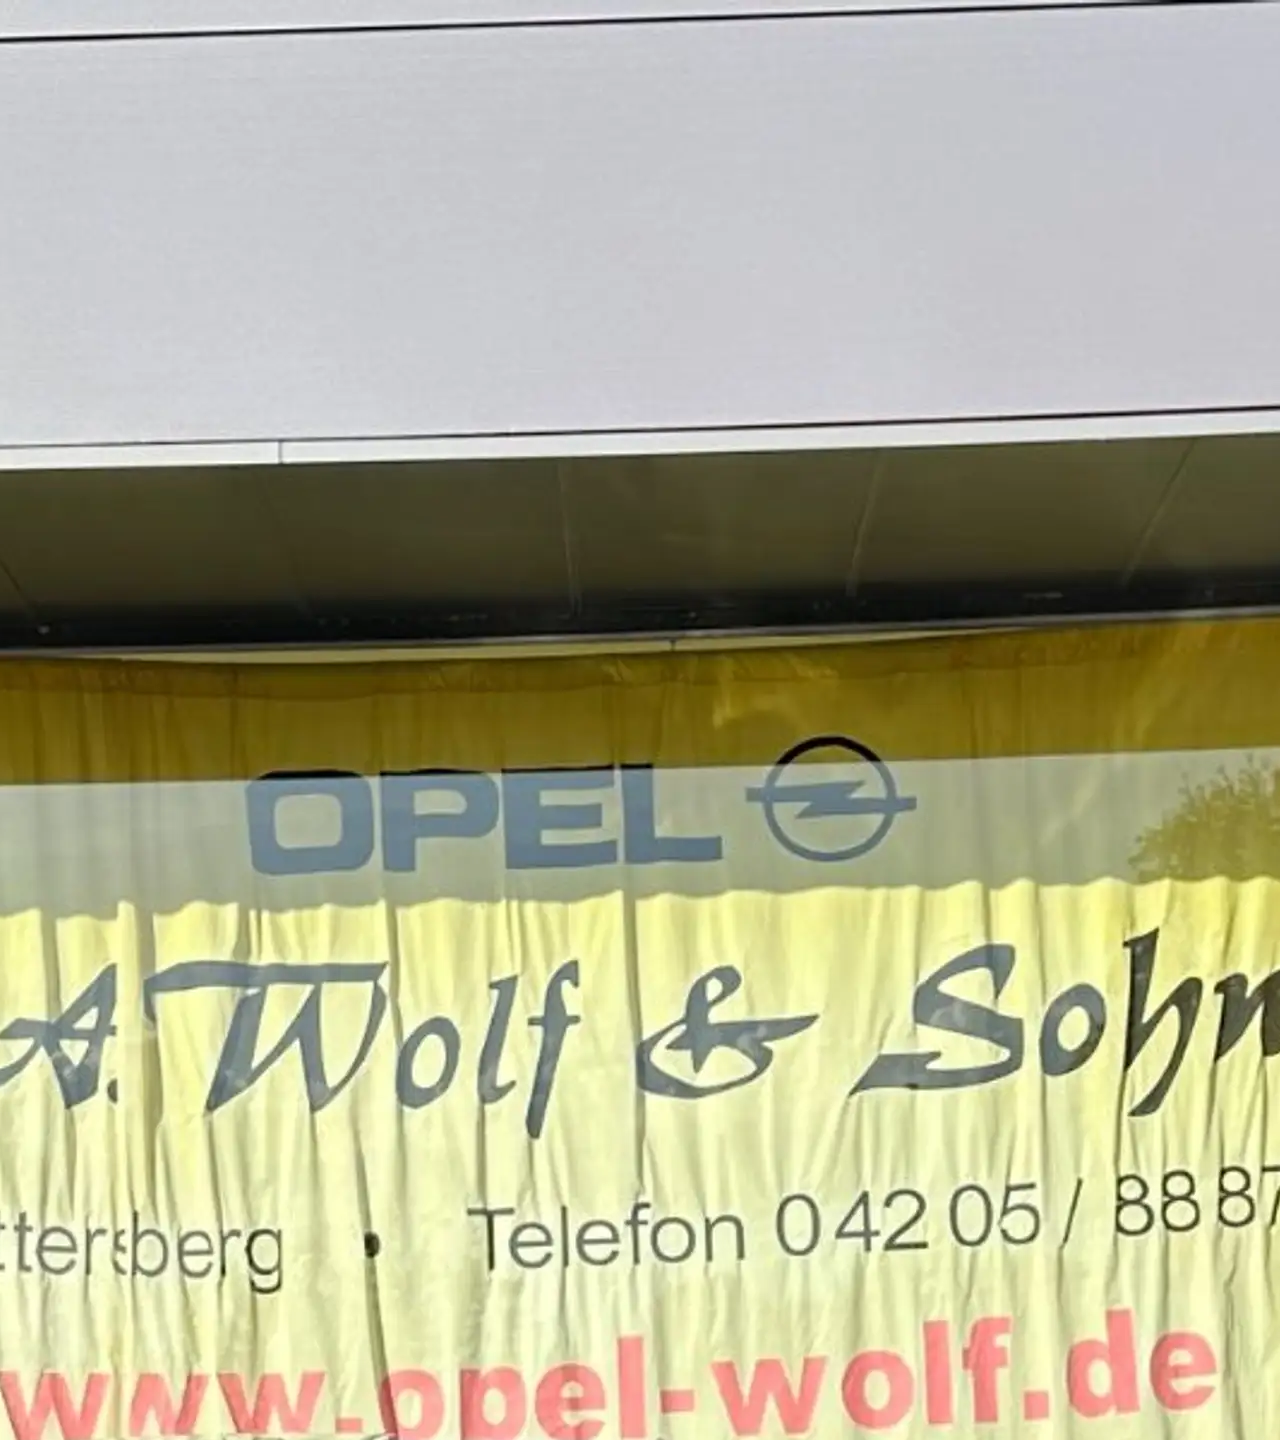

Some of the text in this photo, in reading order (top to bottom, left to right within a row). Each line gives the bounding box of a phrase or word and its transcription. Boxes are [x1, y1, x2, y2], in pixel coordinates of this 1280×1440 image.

[245, 763, 723, 876] OPEL
[144, 958, 582, 1140] Wolf
[635, 964, 821, 1099] &
[466, 1202, 746, 1272] Telefon
